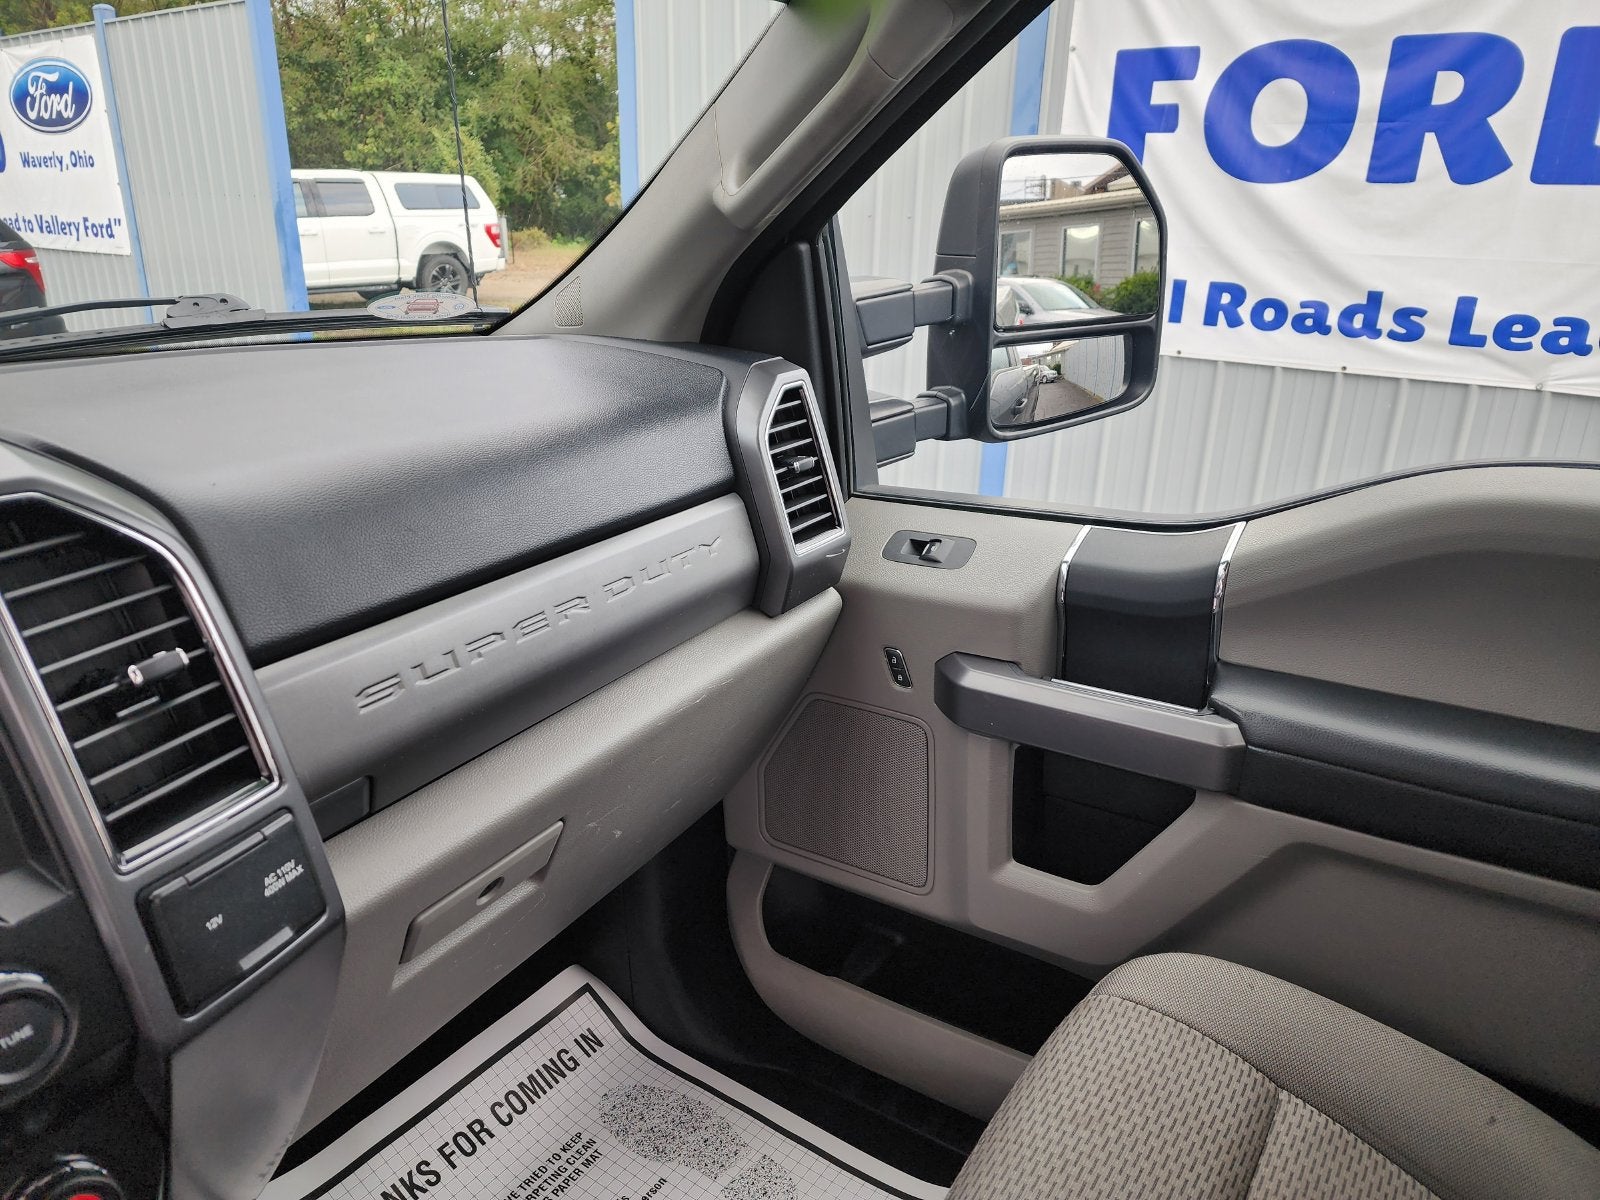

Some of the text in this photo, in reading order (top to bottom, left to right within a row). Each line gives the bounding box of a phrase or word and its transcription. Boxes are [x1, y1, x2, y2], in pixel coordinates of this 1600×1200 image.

[26, 71, 76, 120] Ford
[69, 150, 95, 168] Ohio
[22, 215, 34, 233] to
[34, 214, 80, 241] Vallery
[83, 216, 121, 239] Ford"
[1203, 280, 1429, 343] Roads
[1448, 295, 1600, 356] Lea
[355, 536, 721, 715] SUPER DUTY
[205, 914, 223, 931] 12V
[379, 1027, 605, 1200] NKS FOR COMING IN
[517, 1132, 582, 1191] TRIED TO KEEP
[525, 1138, 597, 1200] RPETING CLEAN
[551, 1148, 603, 1197] PAPER MAT
